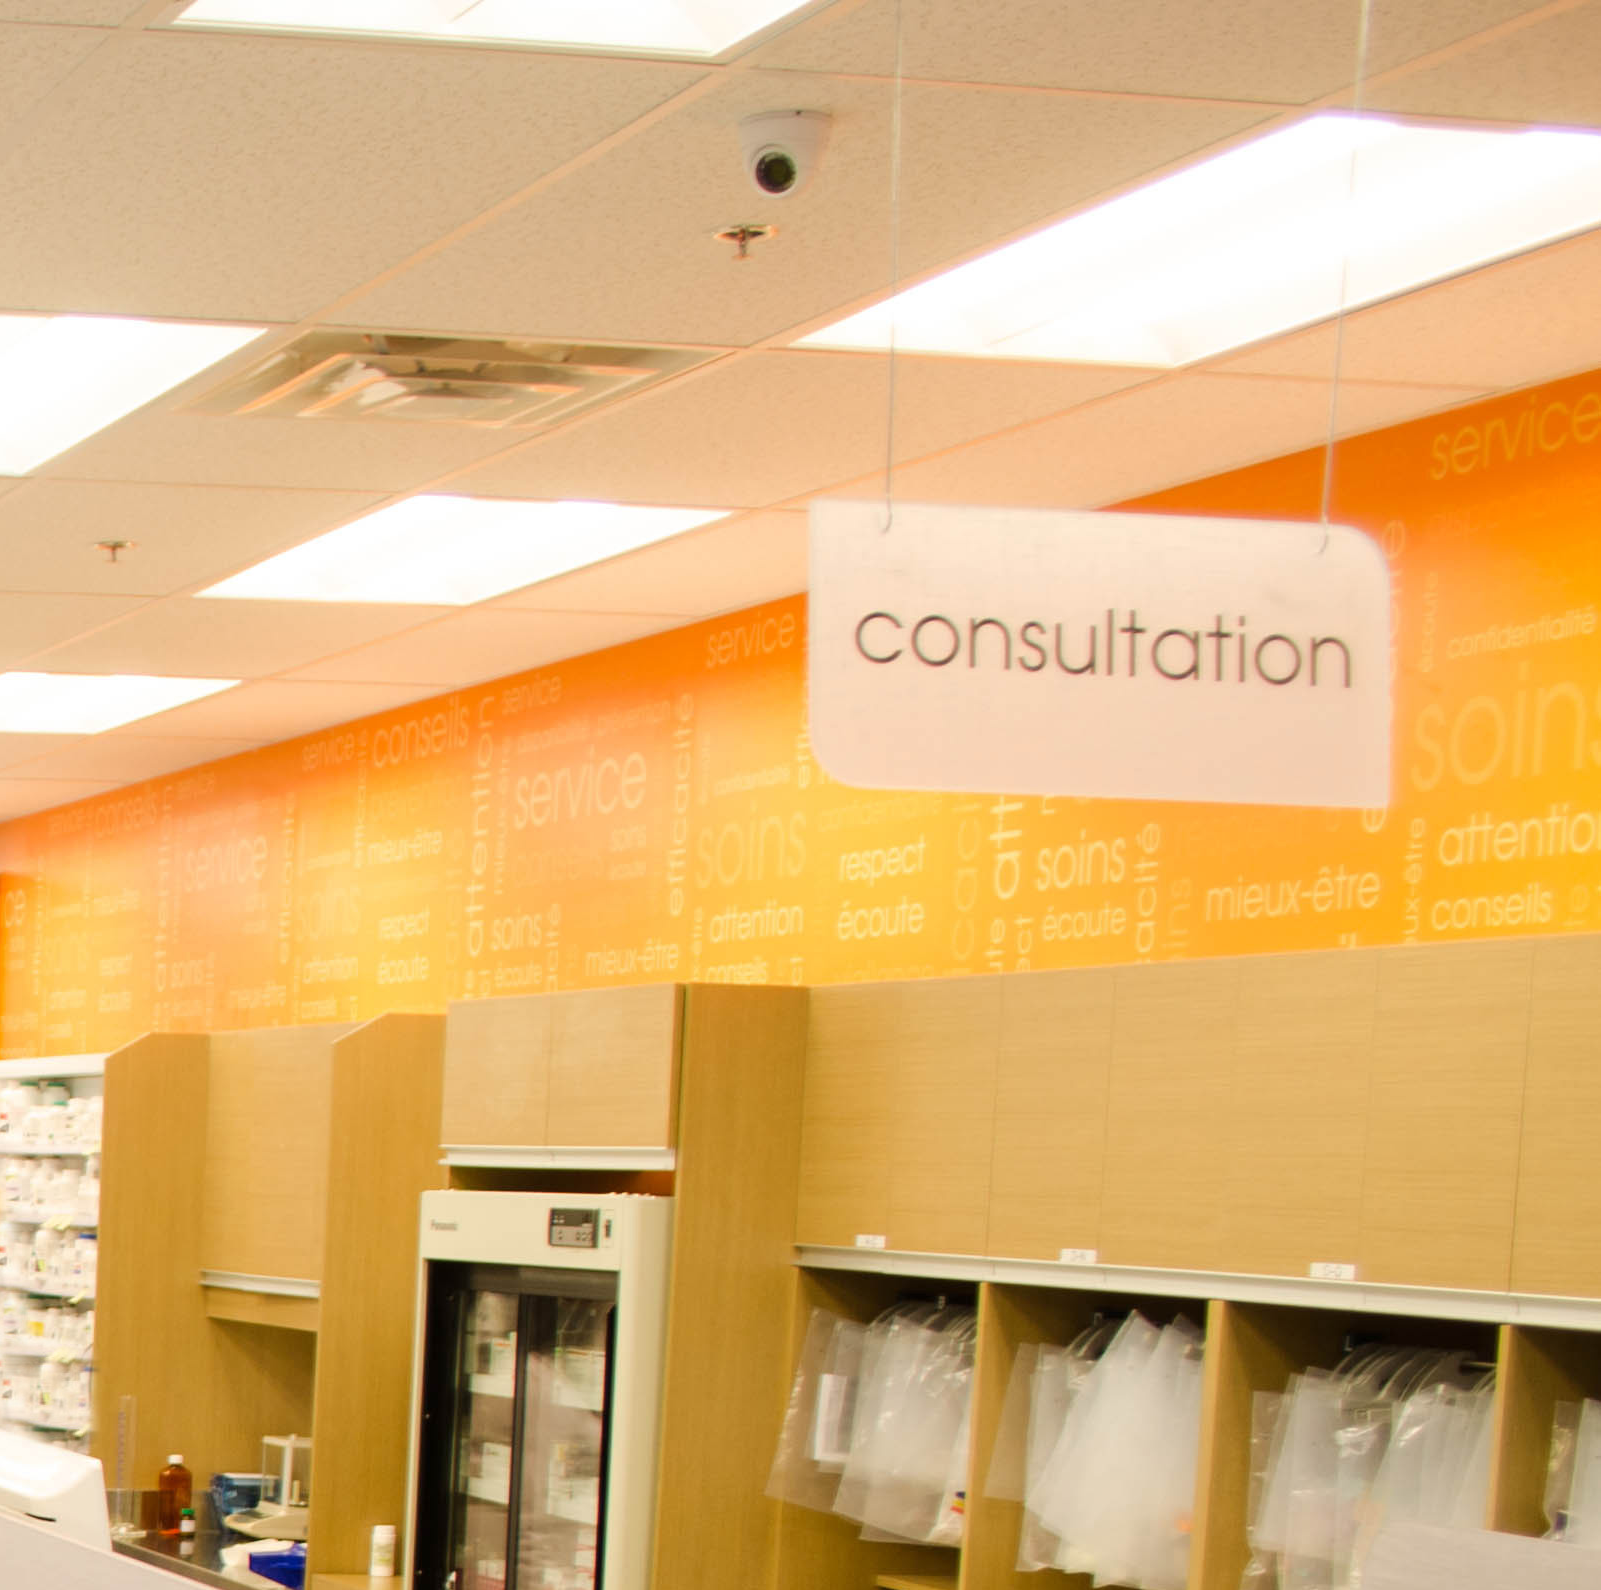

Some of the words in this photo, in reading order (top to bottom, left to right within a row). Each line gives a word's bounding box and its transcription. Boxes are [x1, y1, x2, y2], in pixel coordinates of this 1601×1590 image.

[1431, 393, 1601, 481] service
[705, 611, 796, 669] service
[854, 609, 1352, 688] consultation
[373, 696, 471, 769] conseils
[1411, 660, 1601, 793] soin
[514, 744, 647, 830] service
[693, 800, 807, 889] soins
[838, 832, 926, 887] respect
[1035, 827, 1127, 893] soins
[709, 898, 805, 943] attention
[835, 896, 924, 941] écoute
[1205, 864, 1381, 922] mieux-être
[1431, 882, 1553, 931] conseils
[378, 906, 431, 943] respect
[492, 906, 543, 951] soins
[1041, 902, 1127, 941] écoute
[375, 952, 430, 985] écoute
[584, 938, 680, 977] mieux-être
